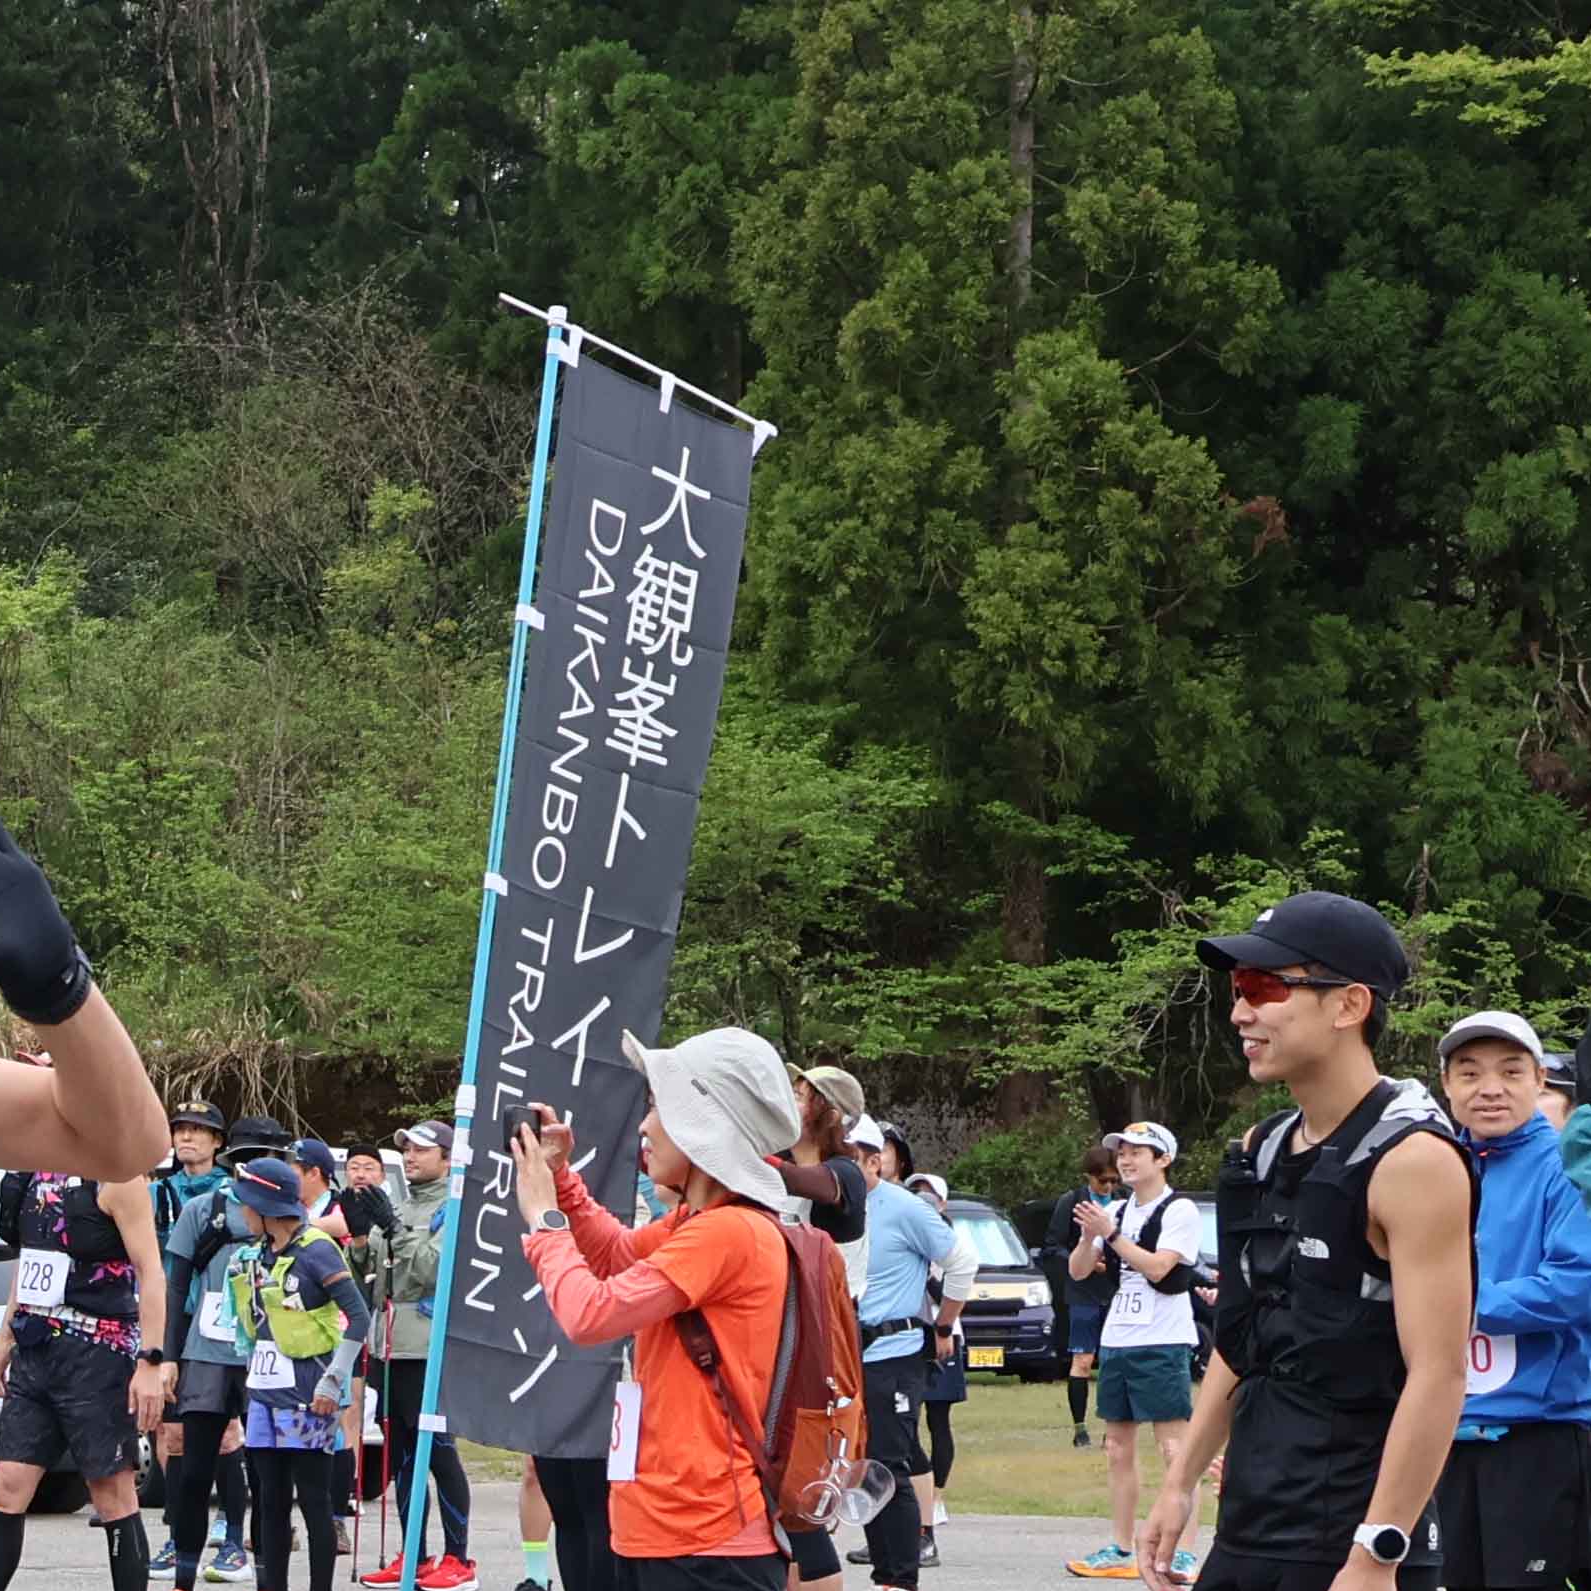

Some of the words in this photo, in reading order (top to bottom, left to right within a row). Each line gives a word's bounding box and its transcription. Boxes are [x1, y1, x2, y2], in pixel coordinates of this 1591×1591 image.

[530, 499, 626, 890] DAIKANBO
[491, 918, 554, 1122] TRAIL
[508, 447, 712, 1403] 大観峯トレイン
[21, 1260, 54, 1292] 228
[465, 1150, 513, 1312] RUN
